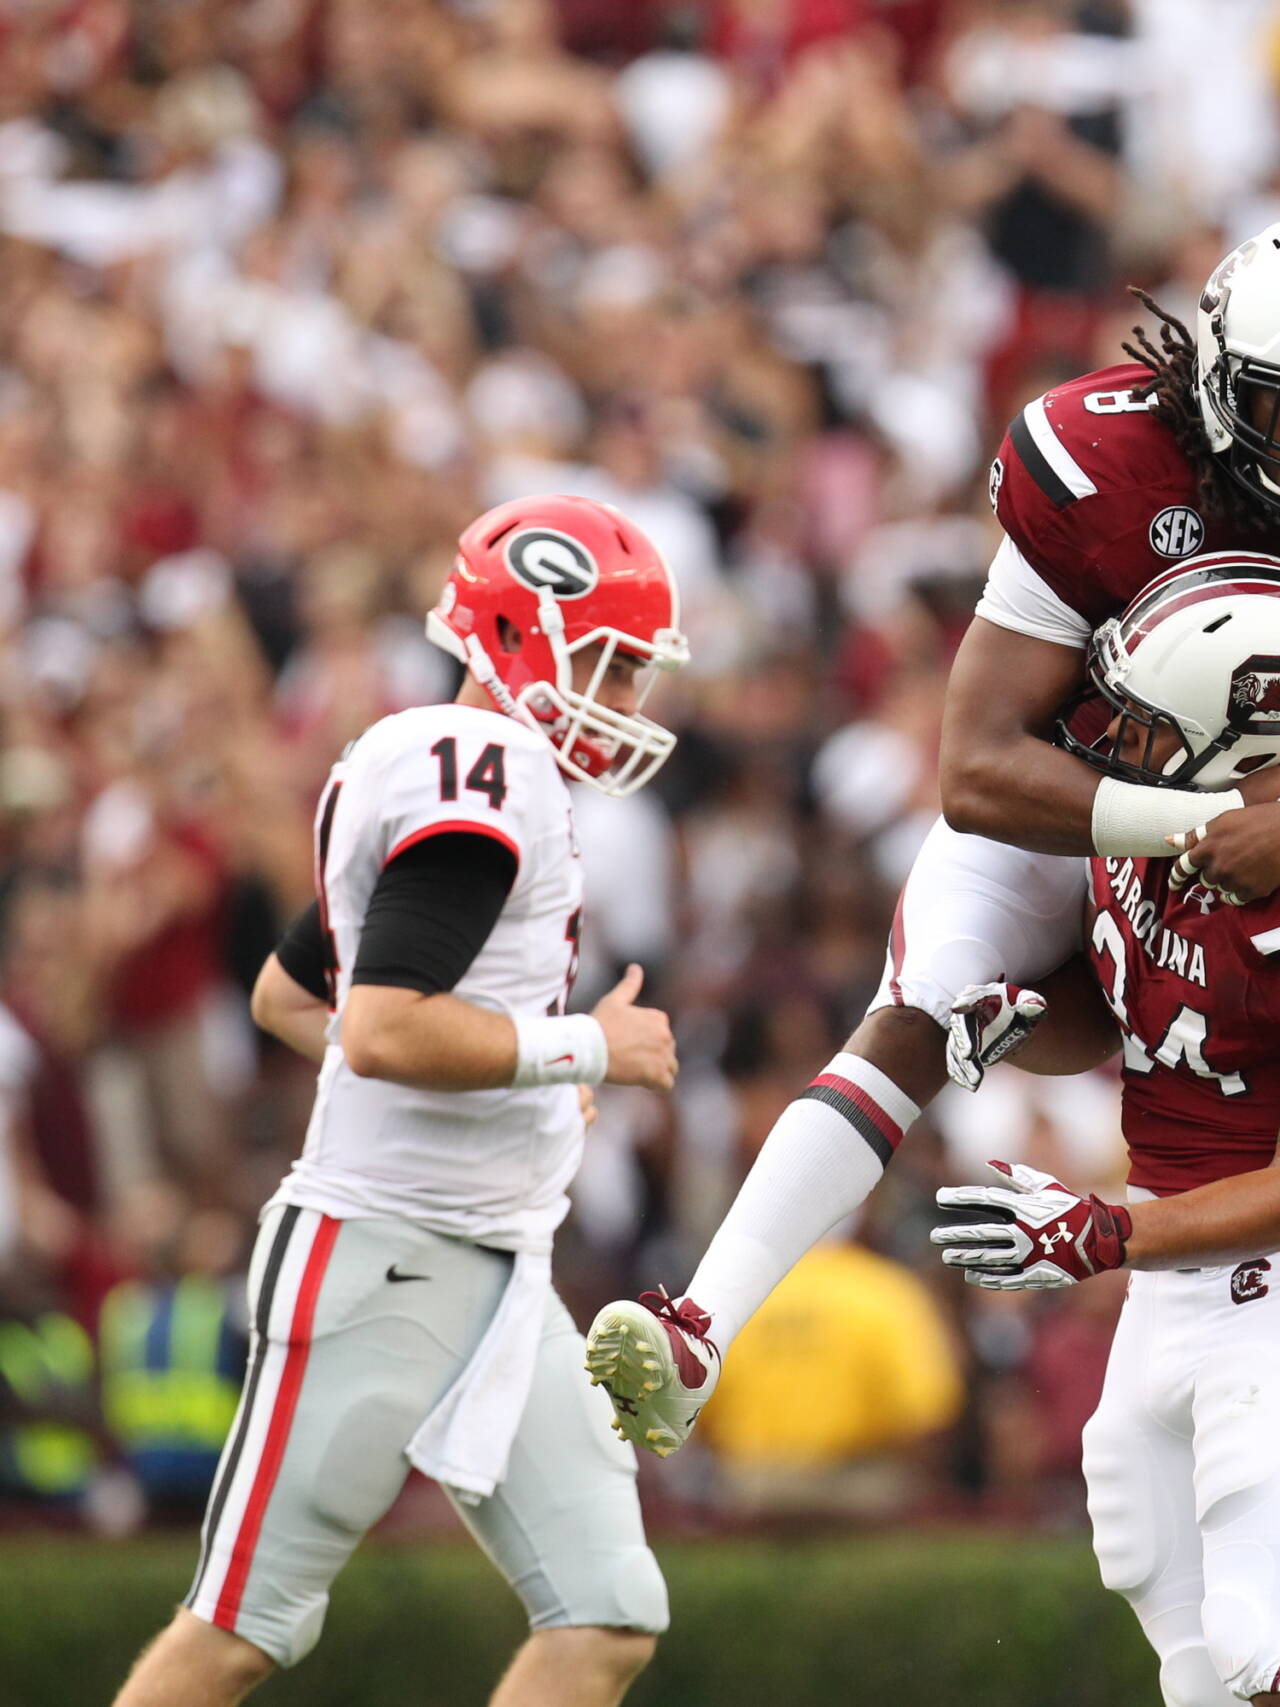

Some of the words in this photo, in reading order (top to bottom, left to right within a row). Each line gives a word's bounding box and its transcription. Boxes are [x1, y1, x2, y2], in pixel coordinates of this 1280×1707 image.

[508, 530, 595, 597] G
[1154, 510, 1200, 555] SEC
[430, 736, 508, 812] 14
